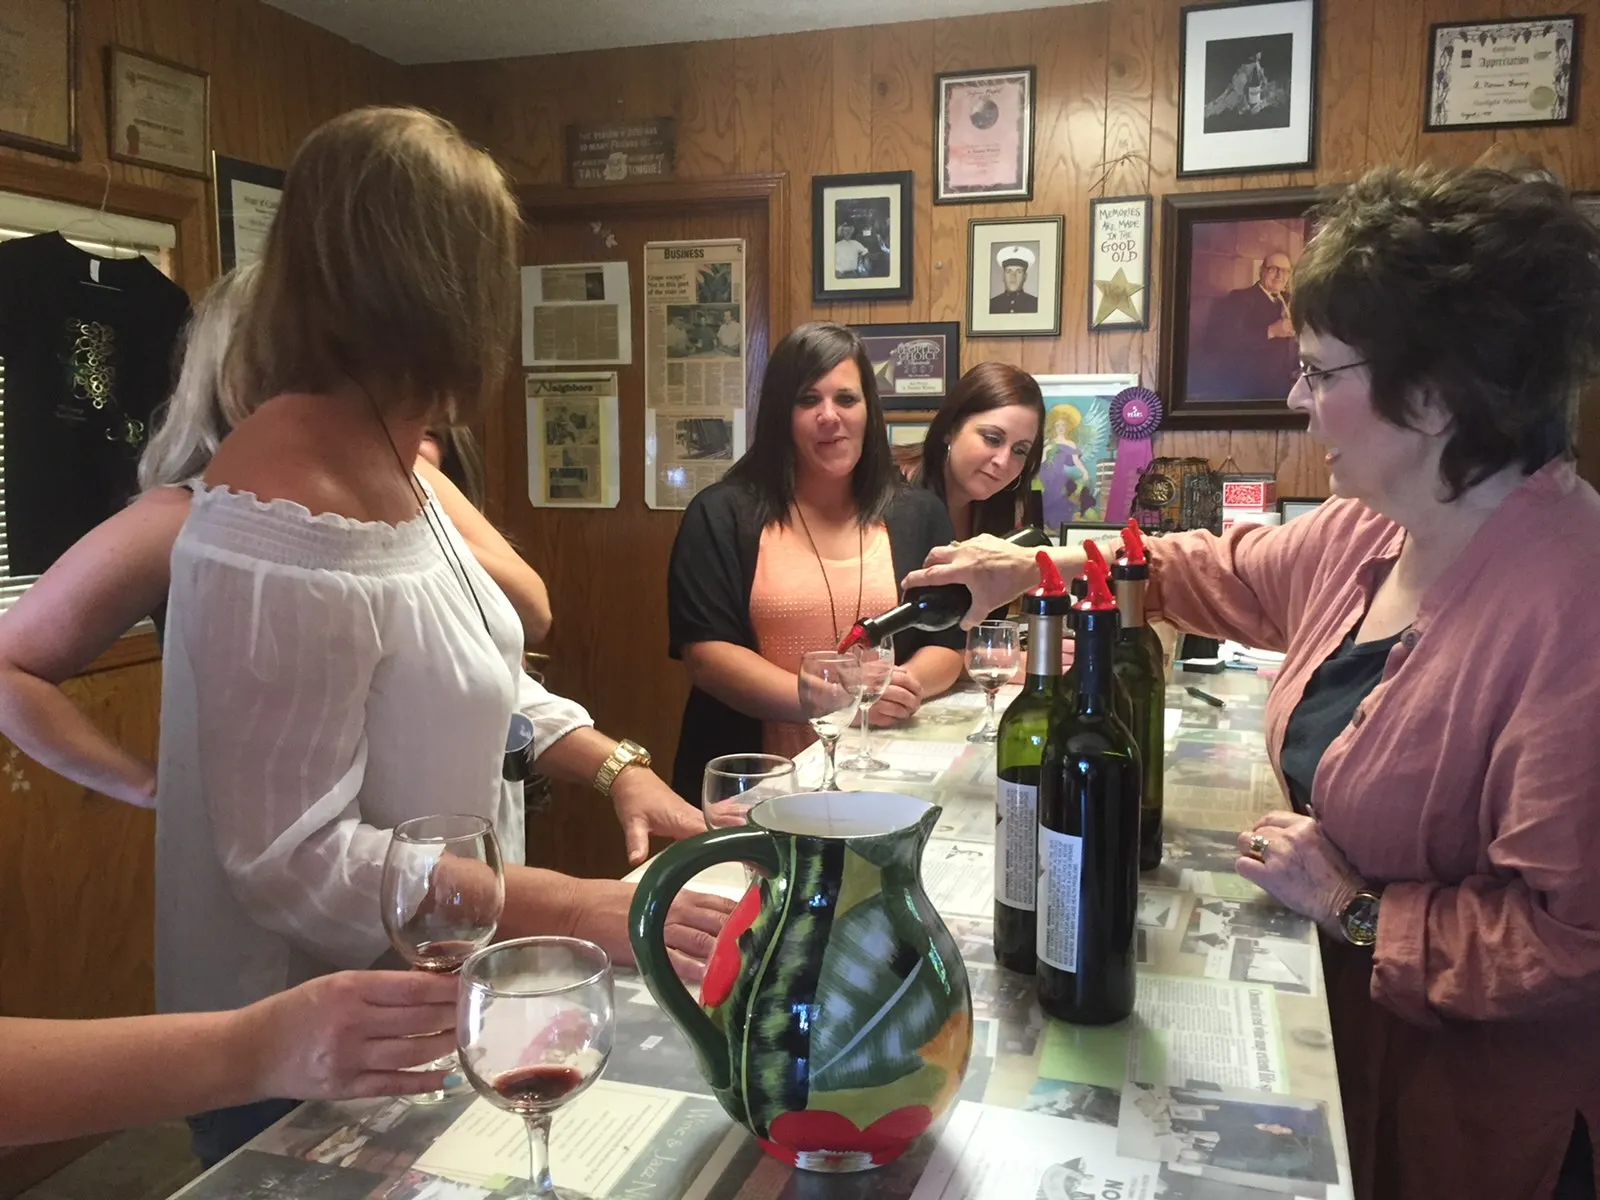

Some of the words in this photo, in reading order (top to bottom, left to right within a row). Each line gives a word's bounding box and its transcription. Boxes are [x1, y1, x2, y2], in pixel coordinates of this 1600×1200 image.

[1478, 56, 1530, 69] Appreciation
[577, 168, 602, 179] TAIL
[1099, 208, 1141, 220] MEMORIES
[1118, 220, 1141, 229] MADE
[1100, 239, 1136, 253] GOOD
[664, 248, 705, 260] BUSINESS
[1111, 250, 1138, 262] OLD
[1260, 1072, 1276, 1082] life
[674, 1109, 713, 1136] Wine
[640, 1148, 677, 1179] Jazz
